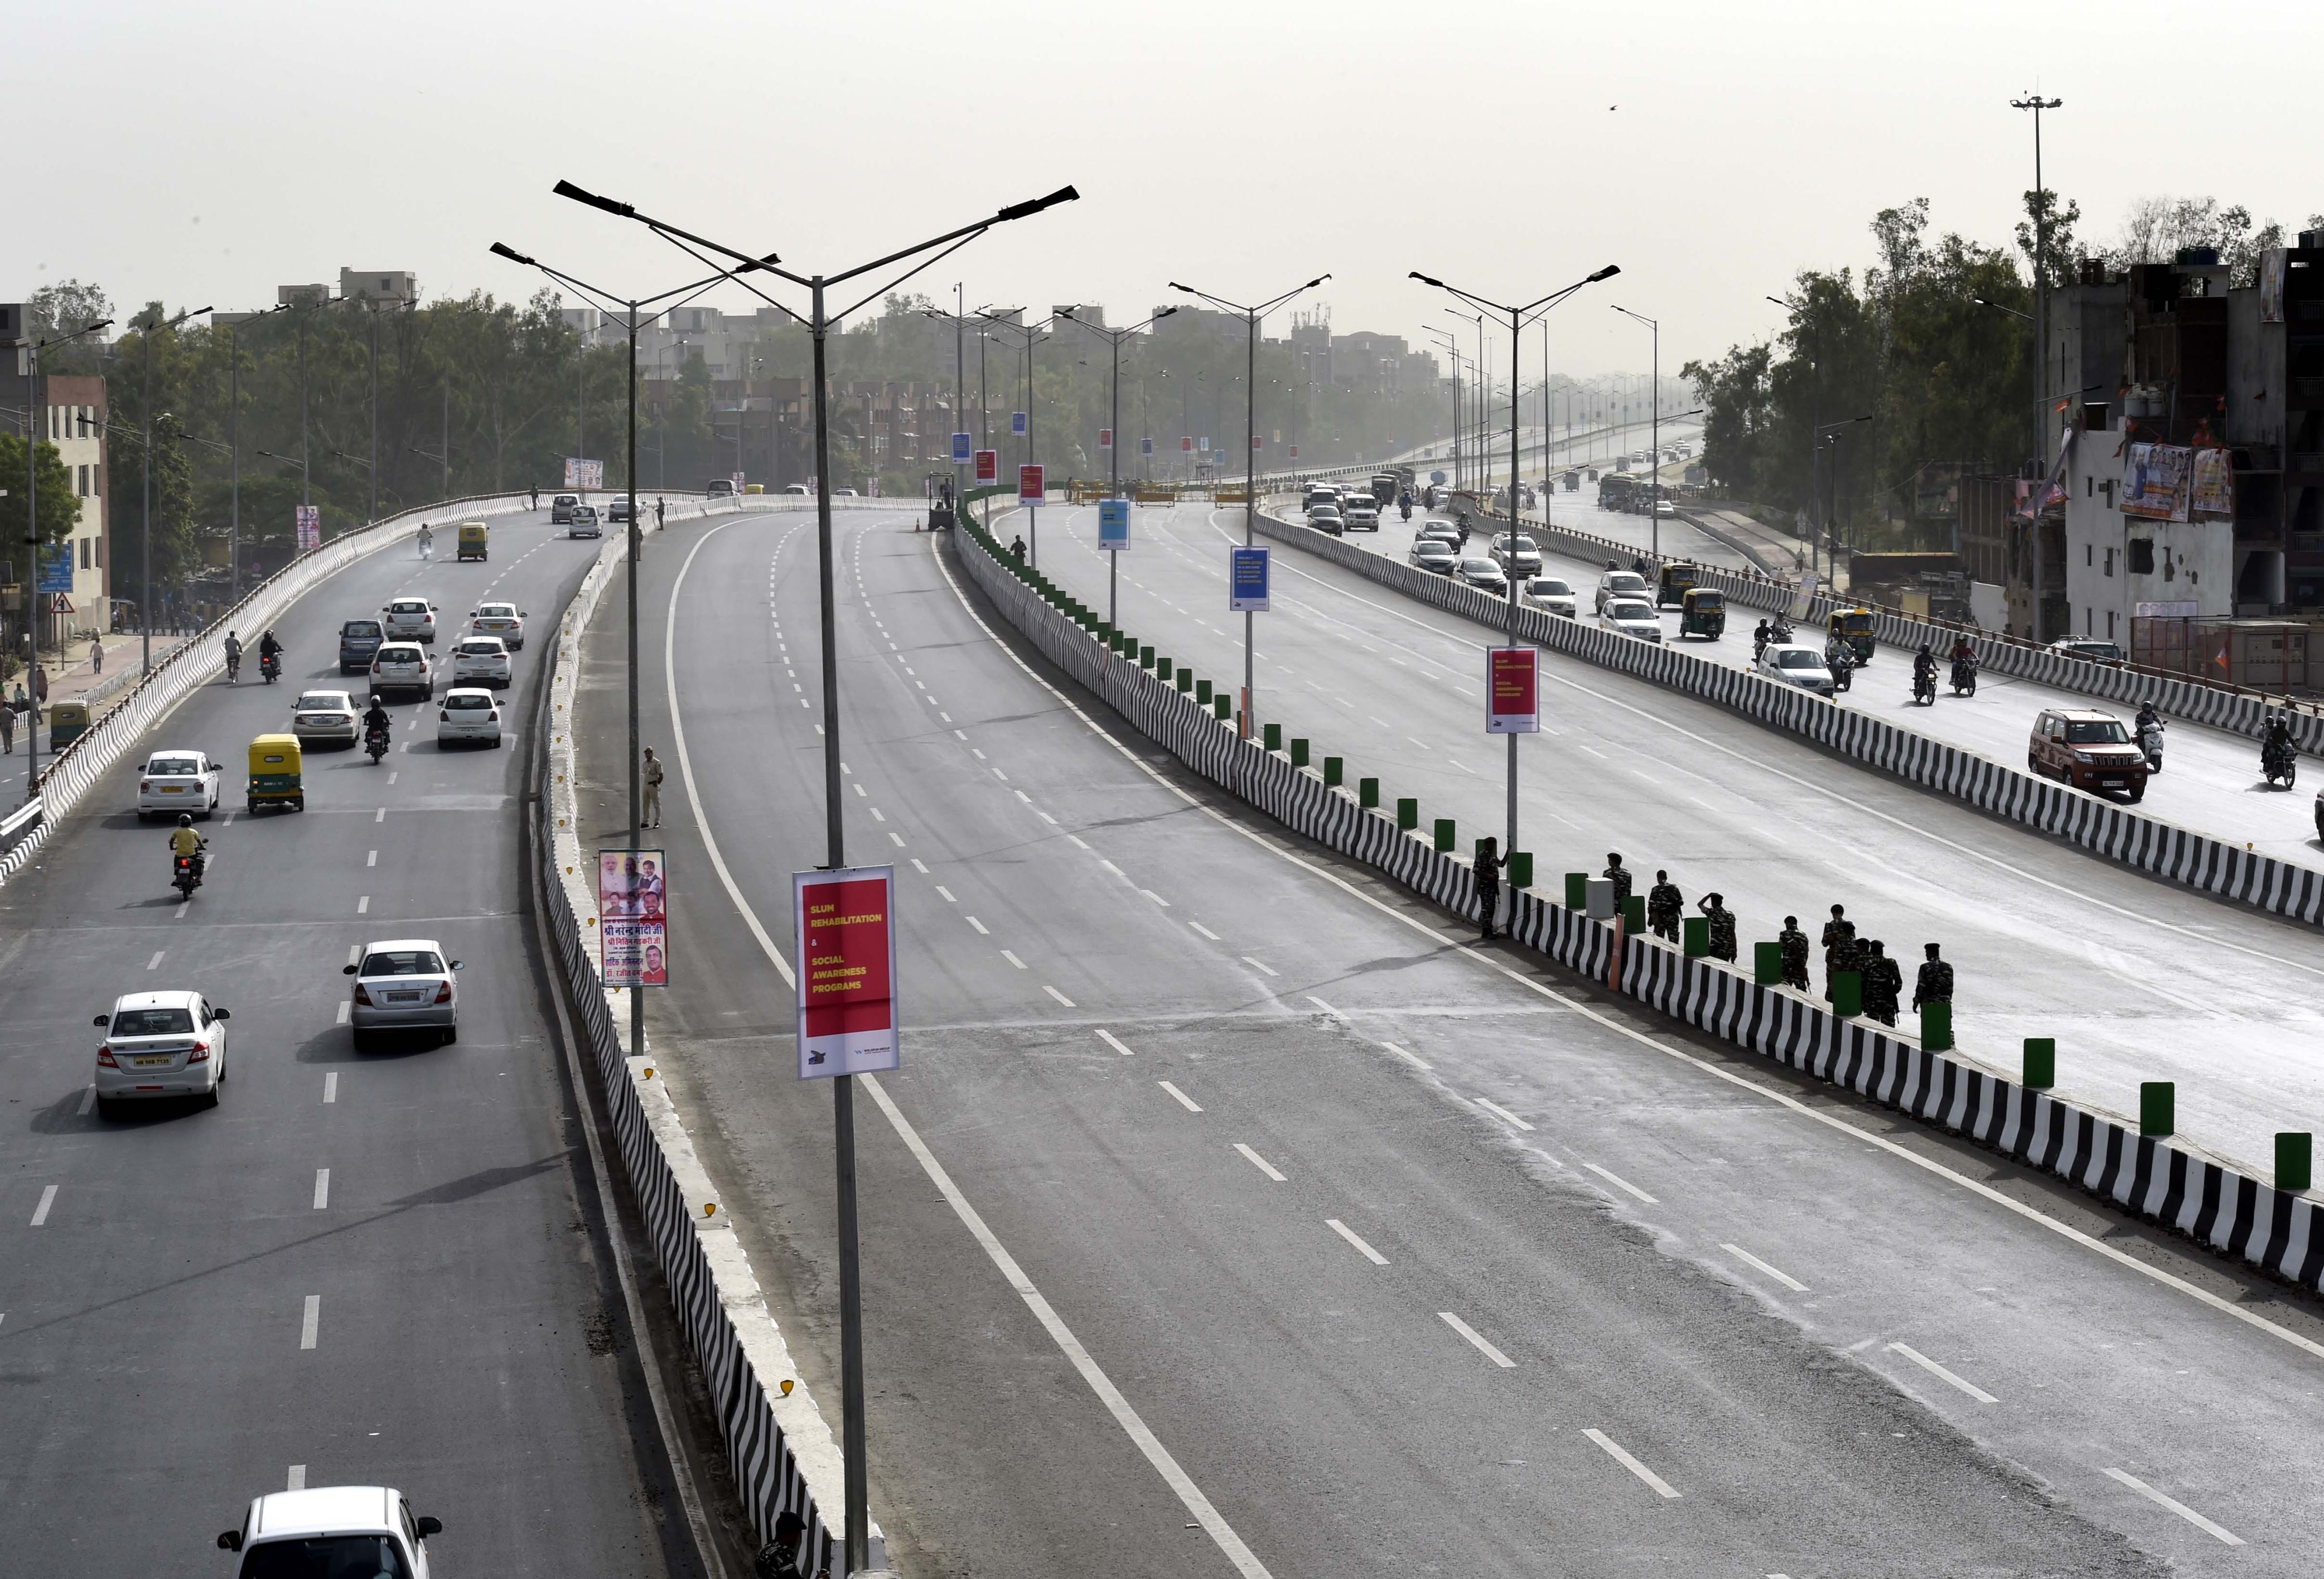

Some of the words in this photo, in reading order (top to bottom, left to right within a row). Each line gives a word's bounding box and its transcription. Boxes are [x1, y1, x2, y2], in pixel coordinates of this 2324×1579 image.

[810, 904, 834, 914] SLUM
[811, 914, 882, 927] REHABILITATION
[605, 925, 613, 936] श्री
[615, 924, 634, 936] नरेन्द्र
[635, 923, 651, 935] मोदी
[653, 923, 663, 935] जी
[812, 955, 844, 965] SOCIAL
[813, 967, 867, 979] AWARENESS
[813, 981, 862, 993] PROGRAMS
